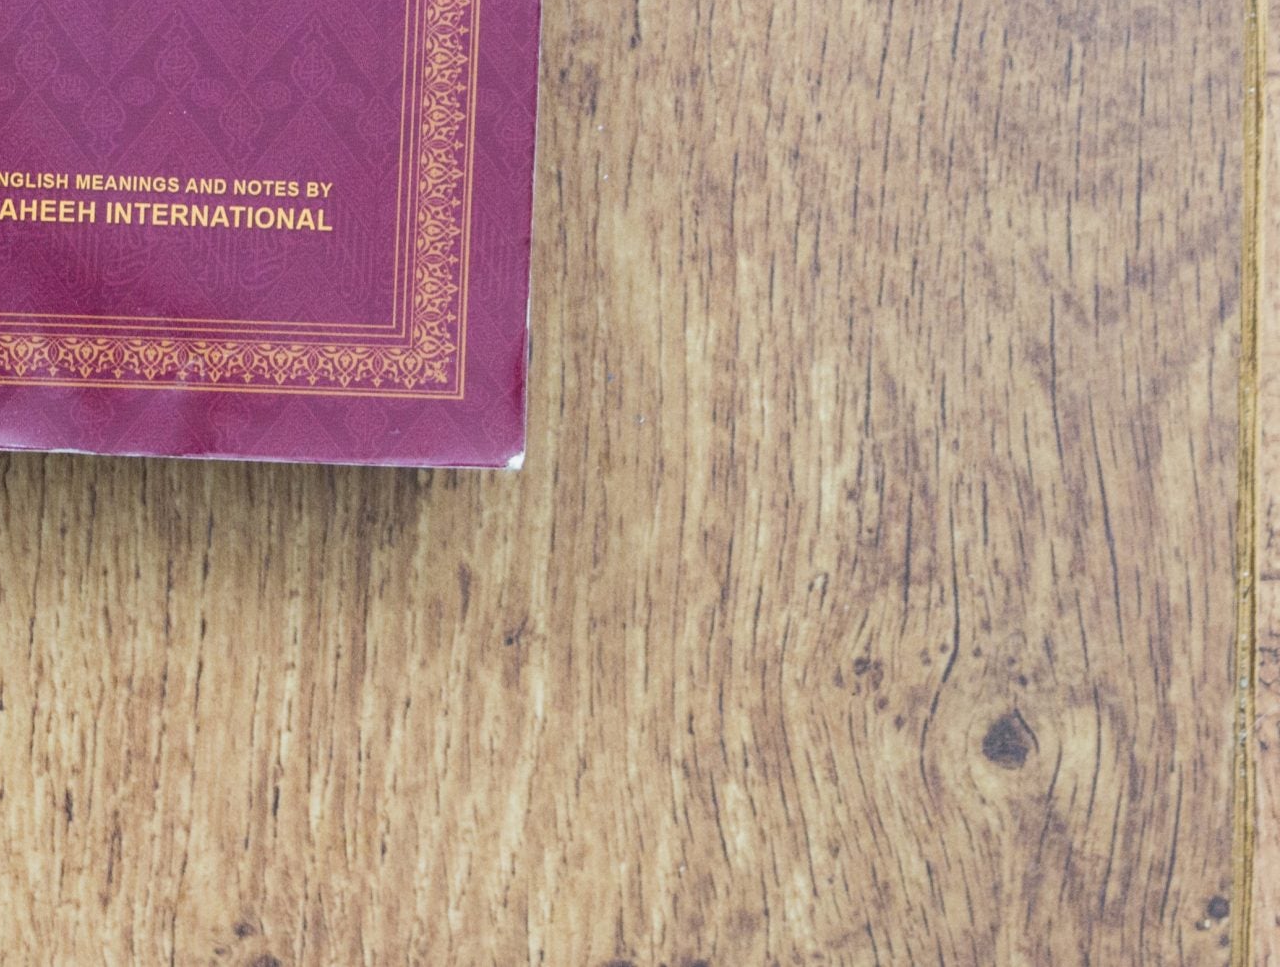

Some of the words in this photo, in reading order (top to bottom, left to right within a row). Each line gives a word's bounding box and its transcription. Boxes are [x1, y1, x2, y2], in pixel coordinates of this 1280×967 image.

[76, 174, 180, 193] MEANINGS
[185, 177, 227, 195] AND
[233, 179, 300, 197] NOTES
[306, 182, 333, 198] BY
[106, 202, 333, 231] INTERNATIONAL
